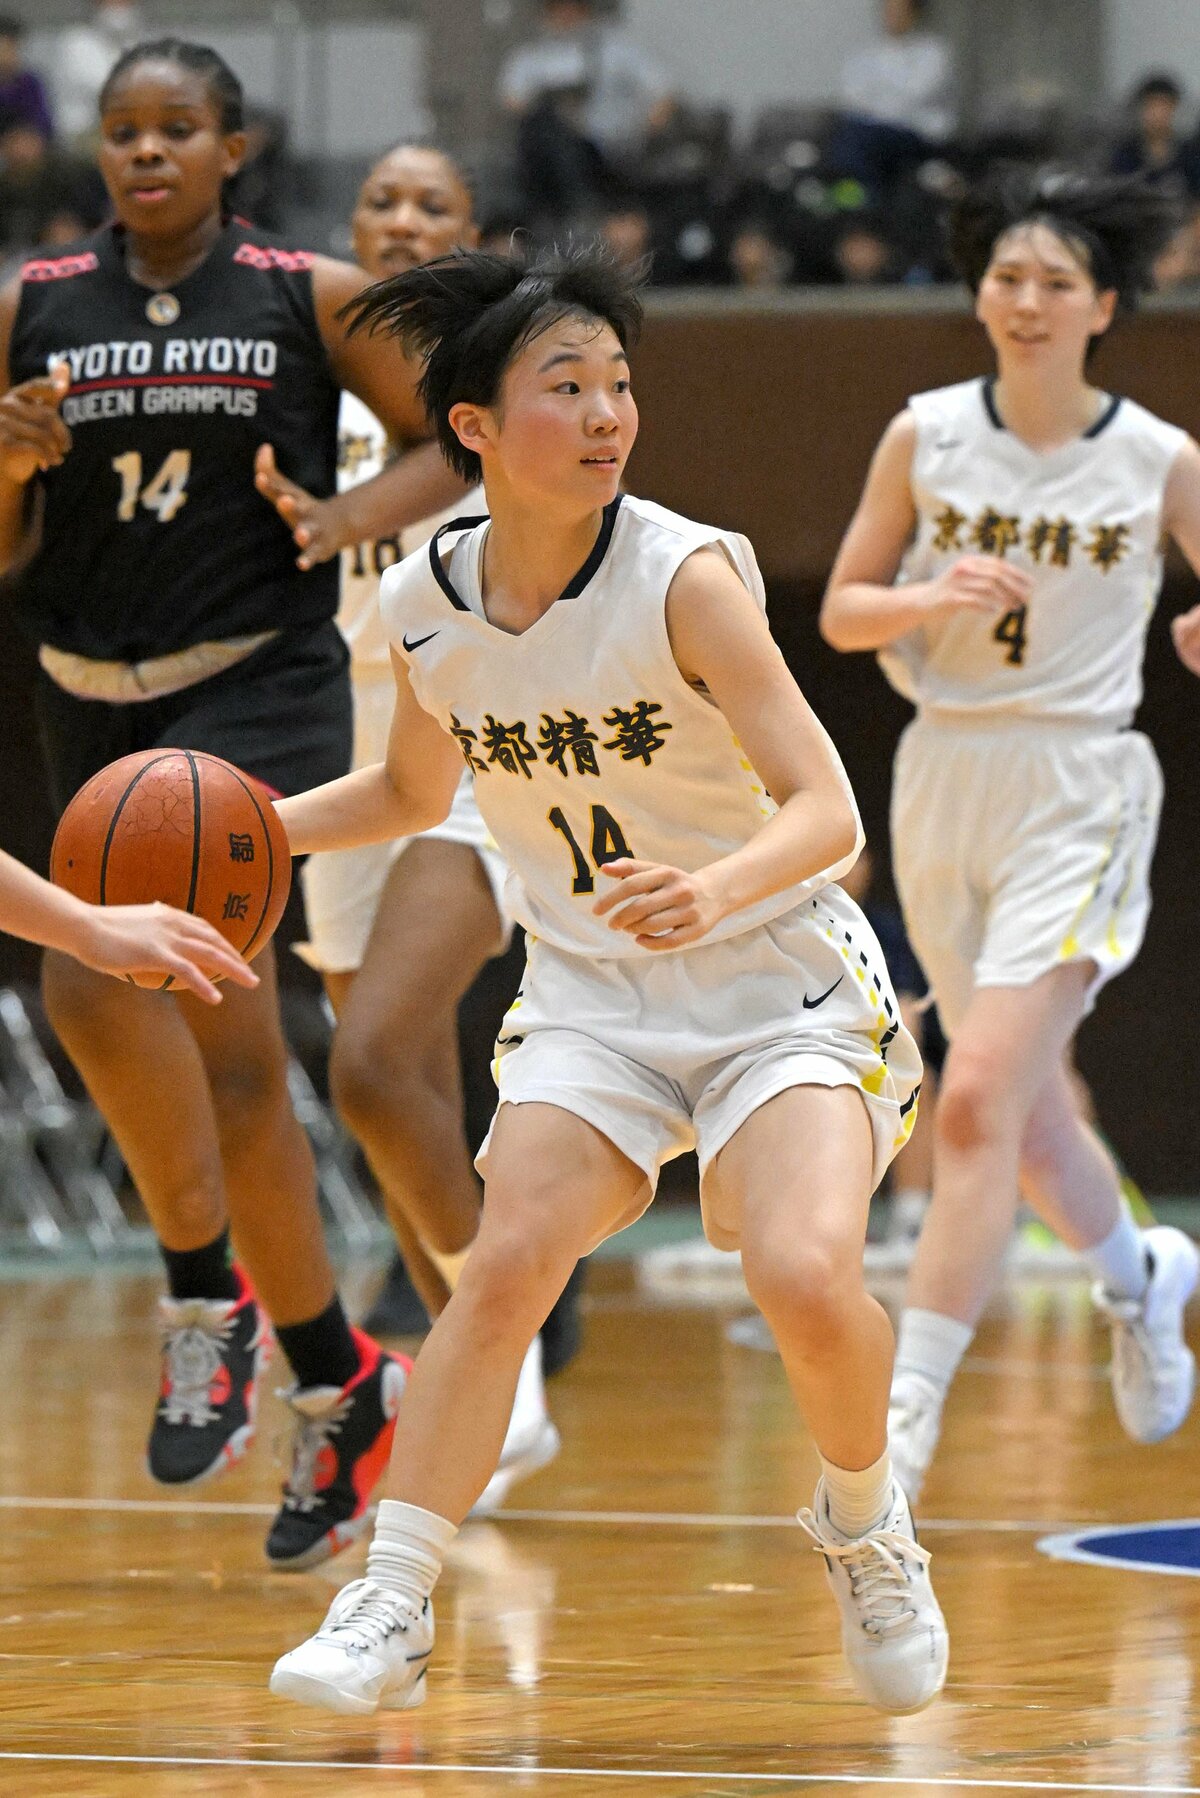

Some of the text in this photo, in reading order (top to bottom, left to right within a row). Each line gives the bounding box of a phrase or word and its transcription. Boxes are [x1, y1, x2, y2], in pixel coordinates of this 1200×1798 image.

[47, 337, 277, 381] KYOTO RYOYO
[142, 386, 258, 416] GRAMPUS
[112, 449, 192, 522] 14
[995, 602, 1027, 669] 4
[547, 803, 637, 895] 14
